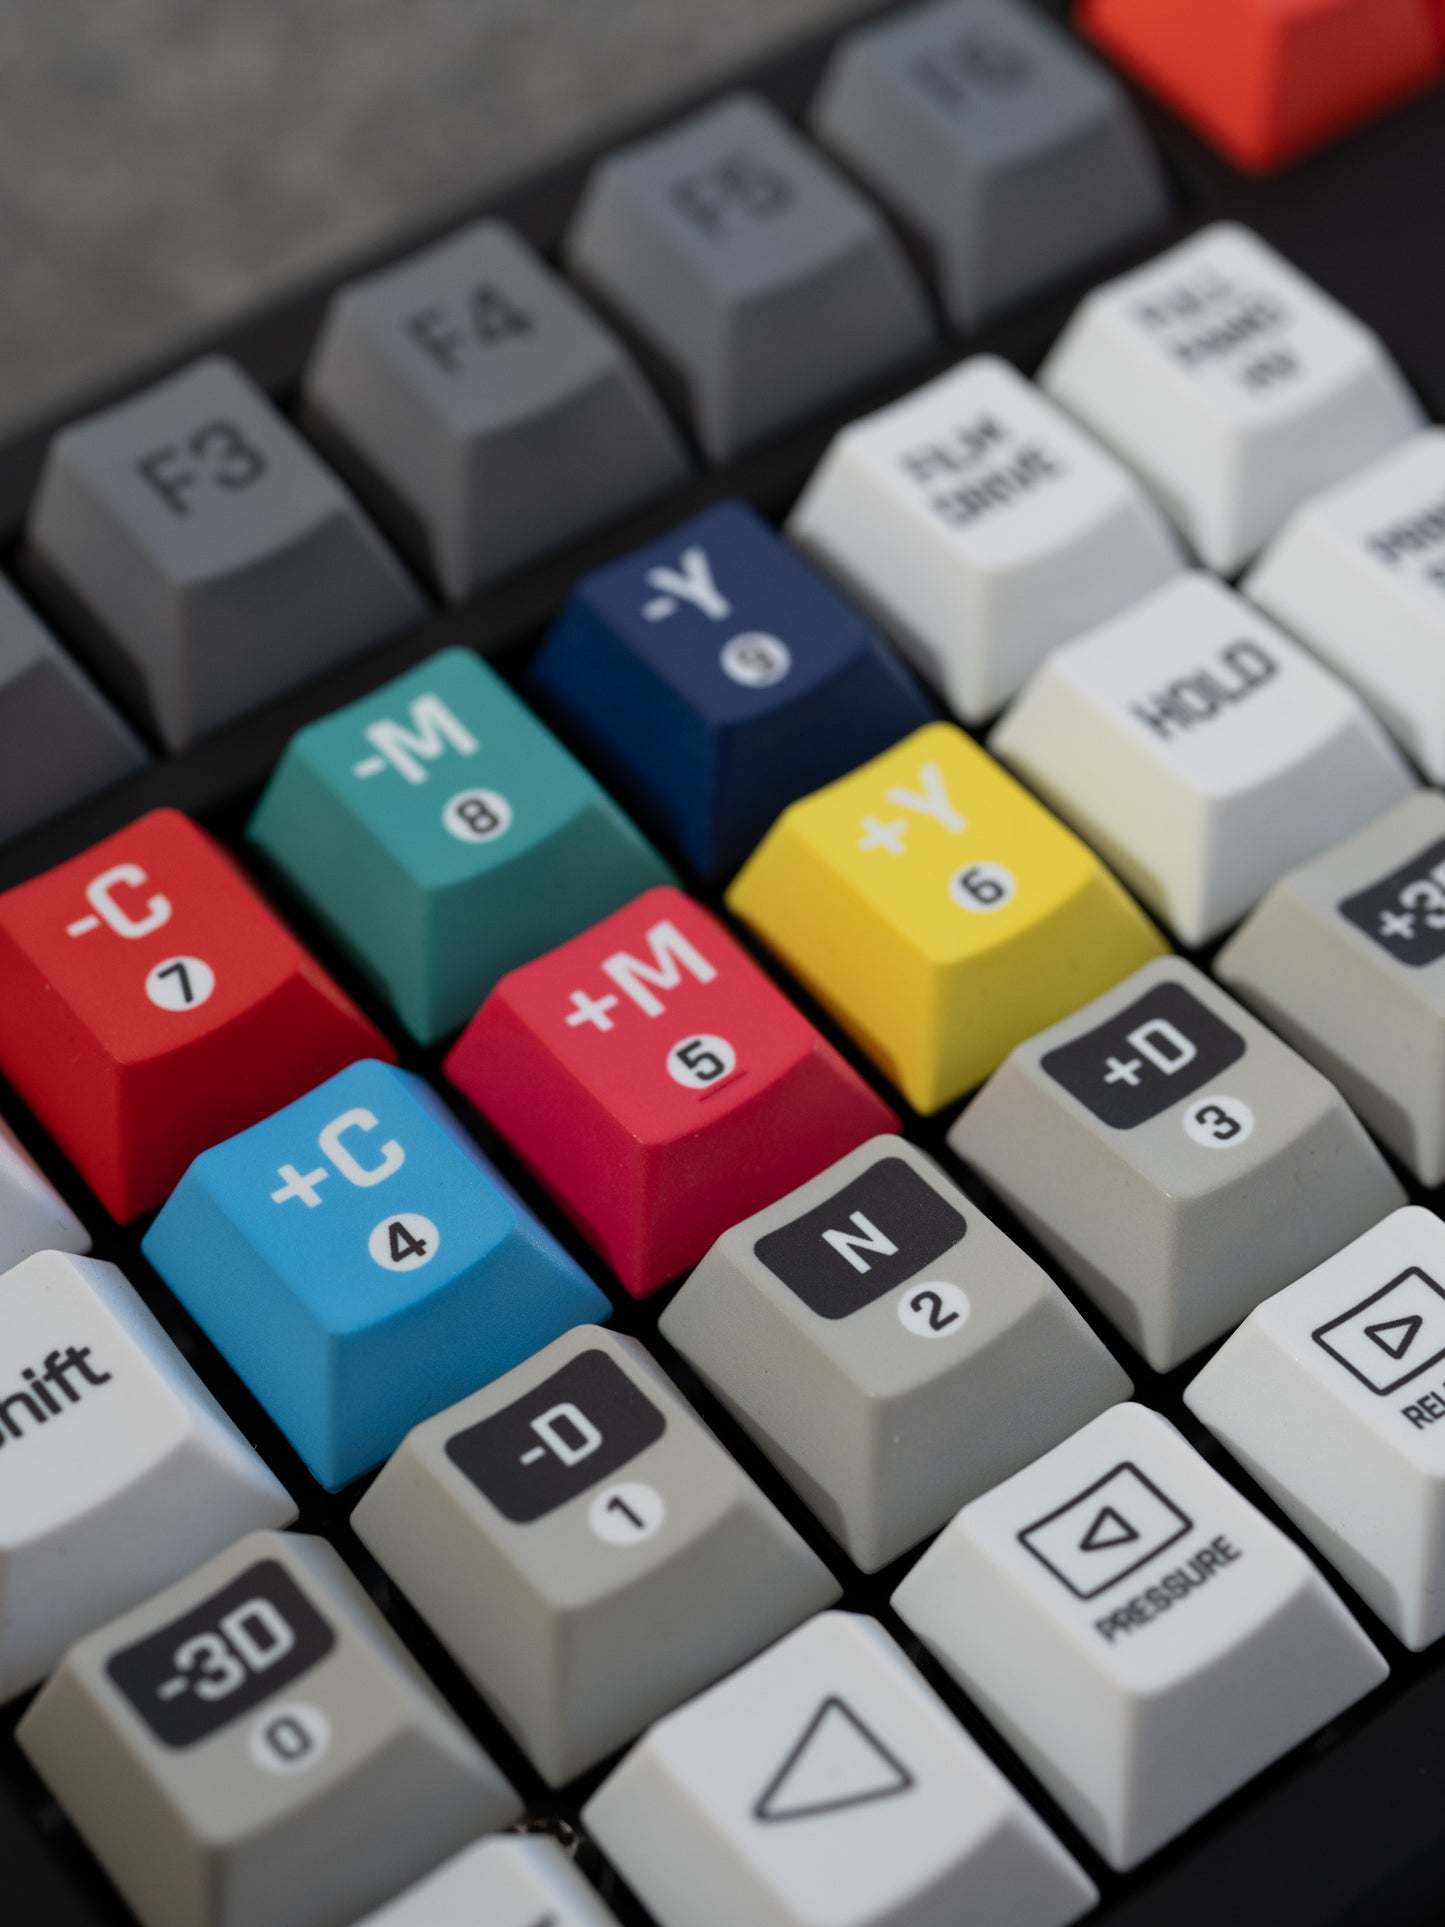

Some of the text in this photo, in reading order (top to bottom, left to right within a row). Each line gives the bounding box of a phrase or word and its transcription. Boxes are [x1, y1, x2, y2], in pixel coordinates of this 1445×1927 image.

[668, 149, 795, 241] F5
[405, 279, 535, 378] F4
[134, 419, 266, 519] F3
[642, 546, 731, 622] -Y
[736, 642, 777, 679] 9
[1130, 635, 1279, 742] HOLD
[353, 692, 479, 785] -M
[456, 797, 500, 835] 8
[857, 761, 966, 855] +Y
[66, 863, 172, 939] -C
[961, 868, 1005, 906] 6
[1378, 857, 1445, 939] +3
[157, 962, 194, 1004] 7
[565, 920, 718, 1032] +M
[676, 1040, 725, 1081] 5
[1103, 1017, 1197, 1087] +D
[270, 1107, 406, 1208] +C
[1194, 1104, 1242, 1141] 3
[388, 1221, 427, 1263] 4
[821, 1210, 899, 1274] N
[909, 1290, 960, 1332] 2
[0, 1346, 112, 1448] hift
[520, 1402, 602, 1466] -D
[606, 1494, 646, 1530] 1
[1095, 1534, 1243, 1644] PRESSURE
[157, 1596, 296, 1702] -3D
[264, 1715, 314, 1764] 0
